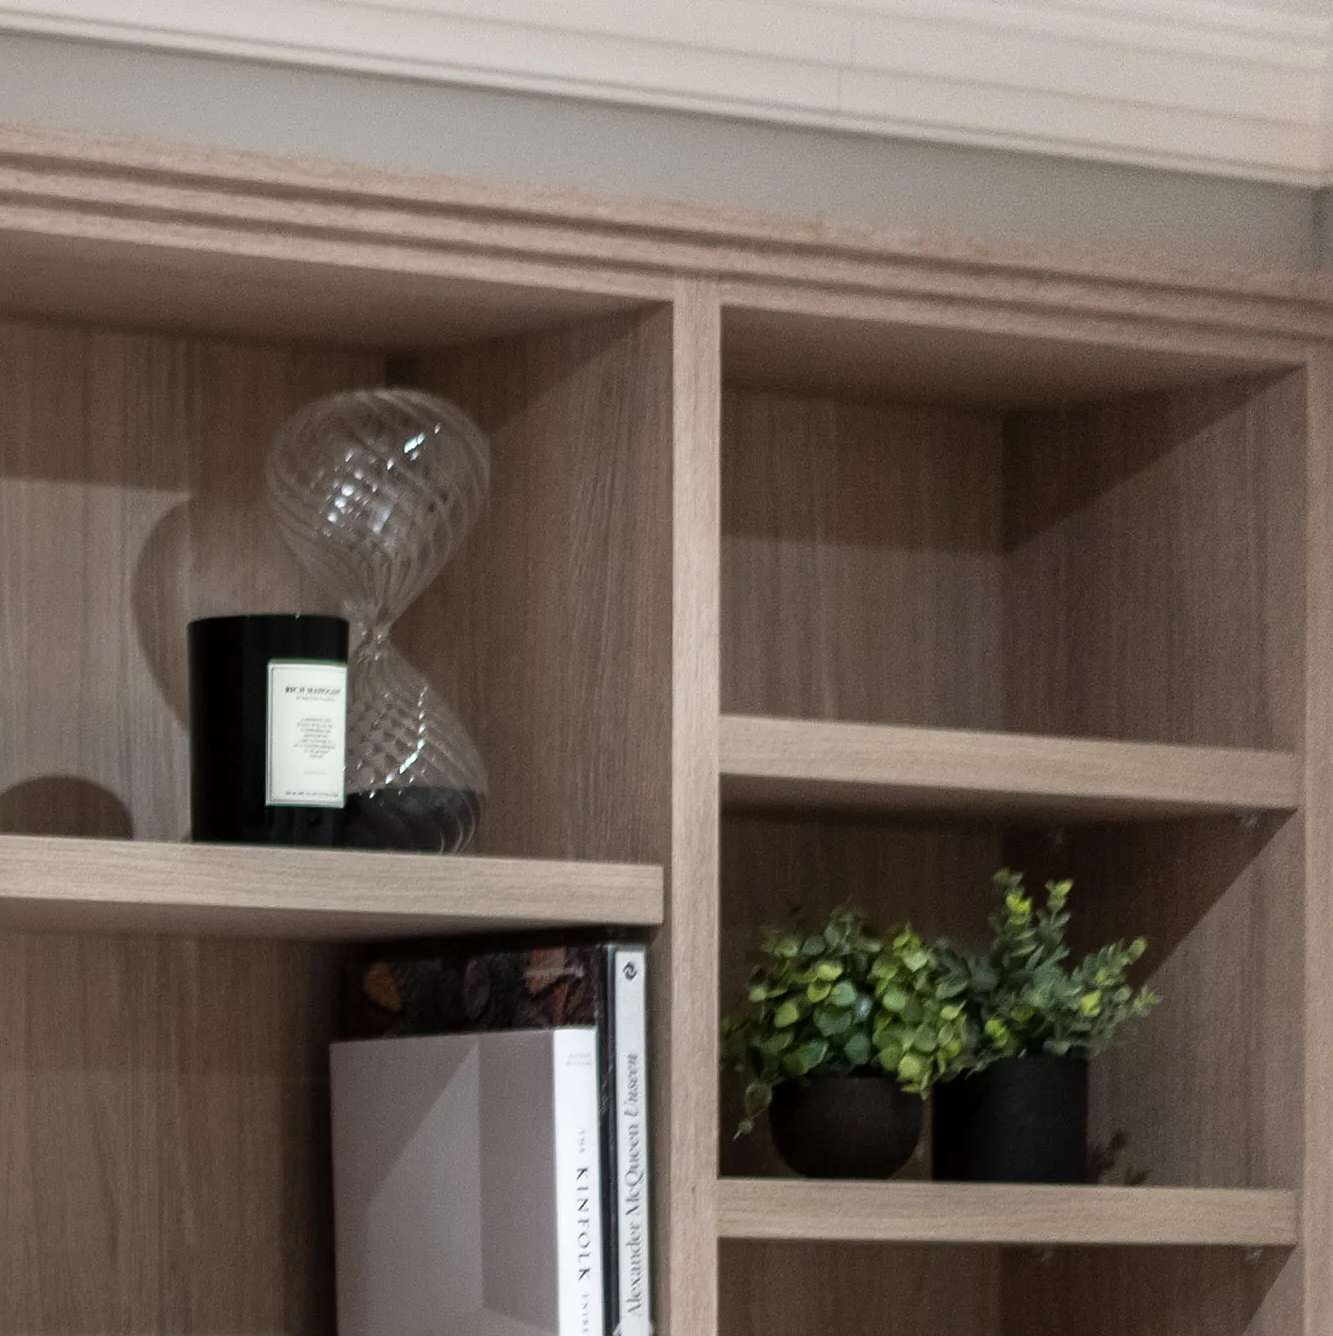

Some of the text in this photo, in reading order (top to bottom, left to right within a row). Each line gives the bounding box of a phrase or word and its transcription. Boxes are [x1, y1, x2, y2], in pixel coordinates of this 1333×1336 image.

[575, 1167, 591, 1281] KINFOLK
[623, 1052, 644, 1319] Alexander McQueen Unseen
